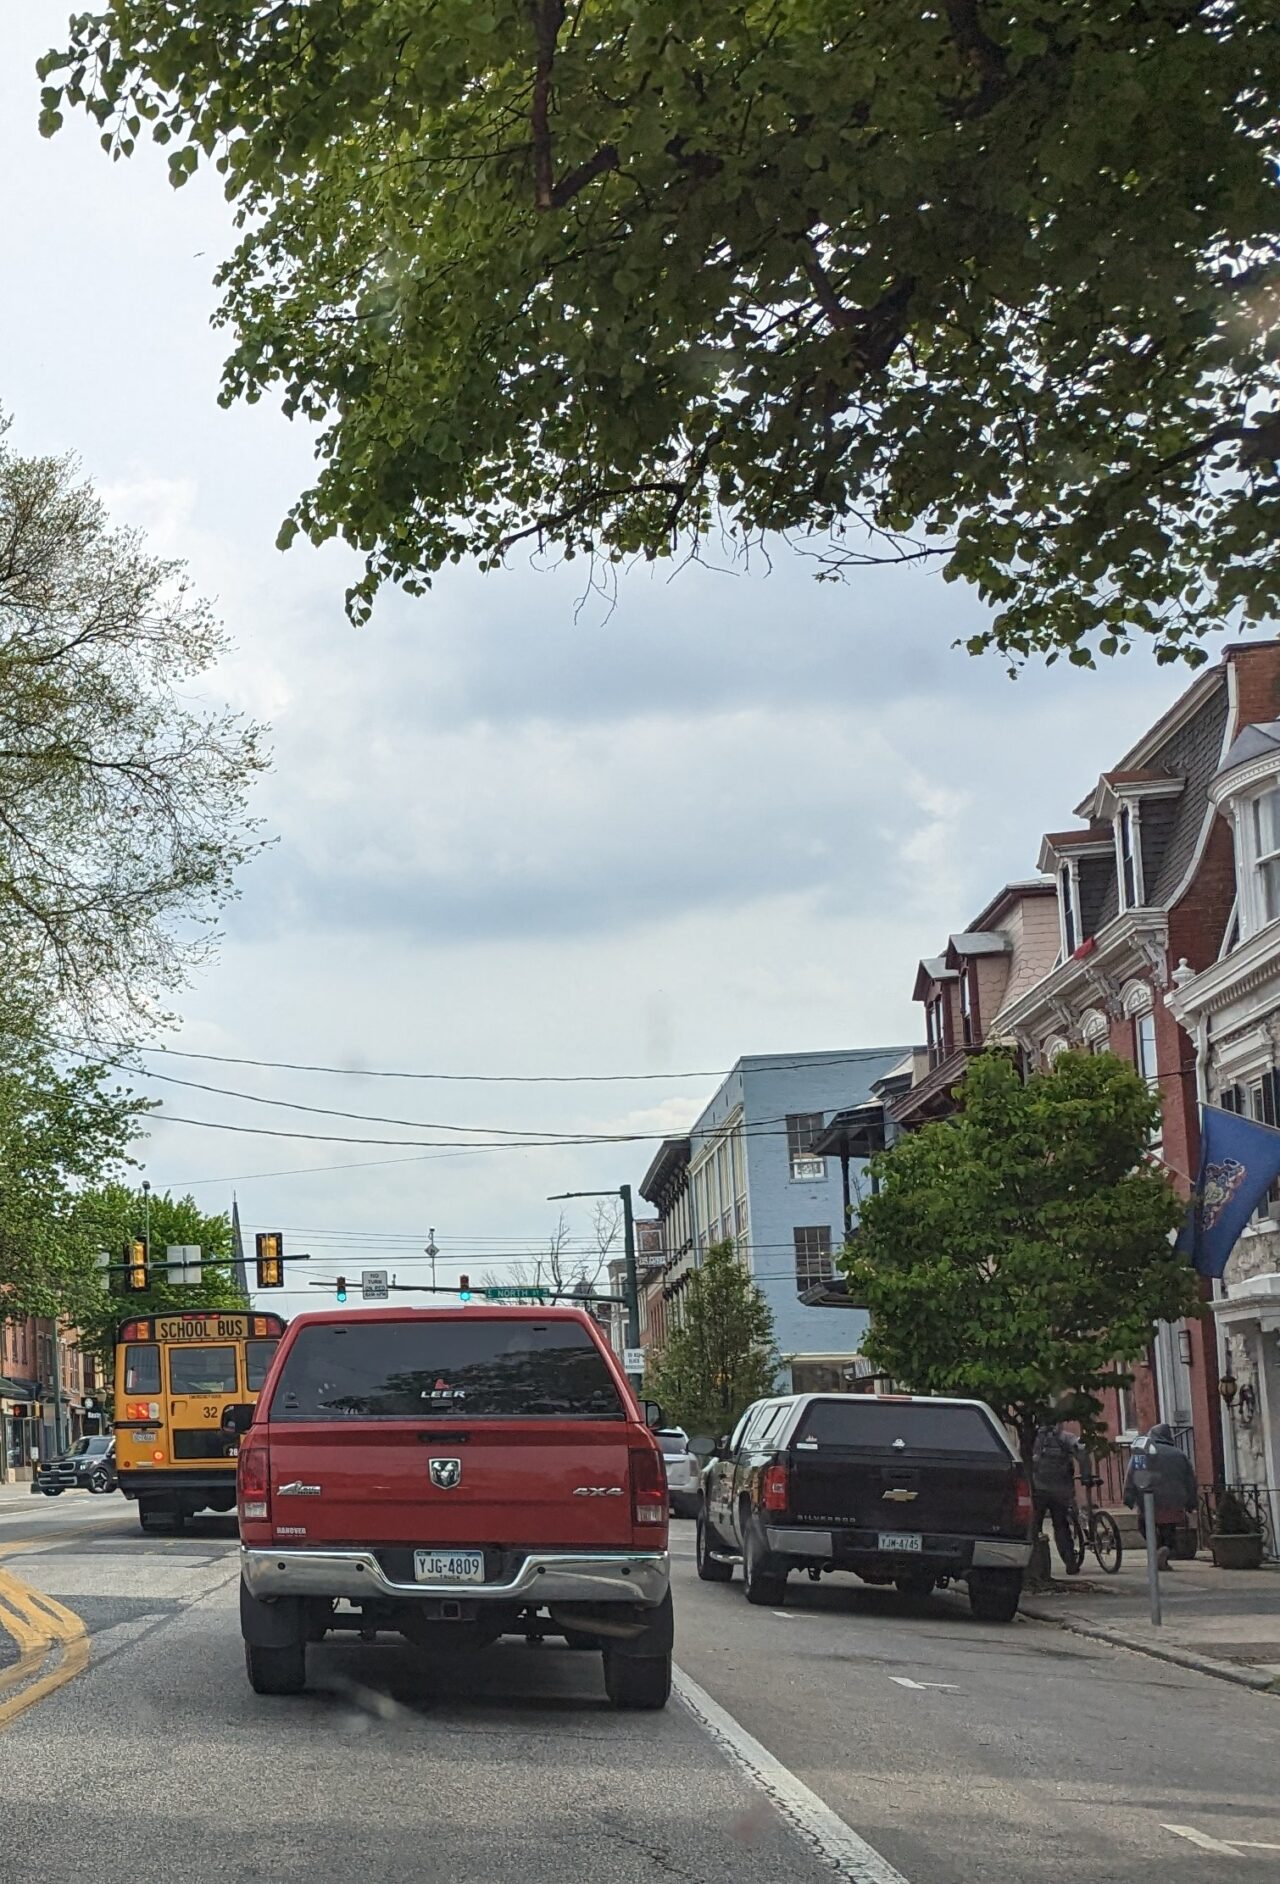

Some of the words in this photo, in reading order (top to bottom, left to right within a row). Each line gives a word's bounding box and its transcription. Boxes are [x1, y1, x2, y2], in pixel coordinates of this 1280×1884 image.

[497, 1289, 528, 1297] NORTH
[160, 1321, 211, 1338] SCHOOL
[217, 1319, 243, 1336] BUS
[420, 1390, 466, 1398] LEER
[203, 1406, 218, 1419] 32
[419, 1558, 480, 1575] YJG-4809
